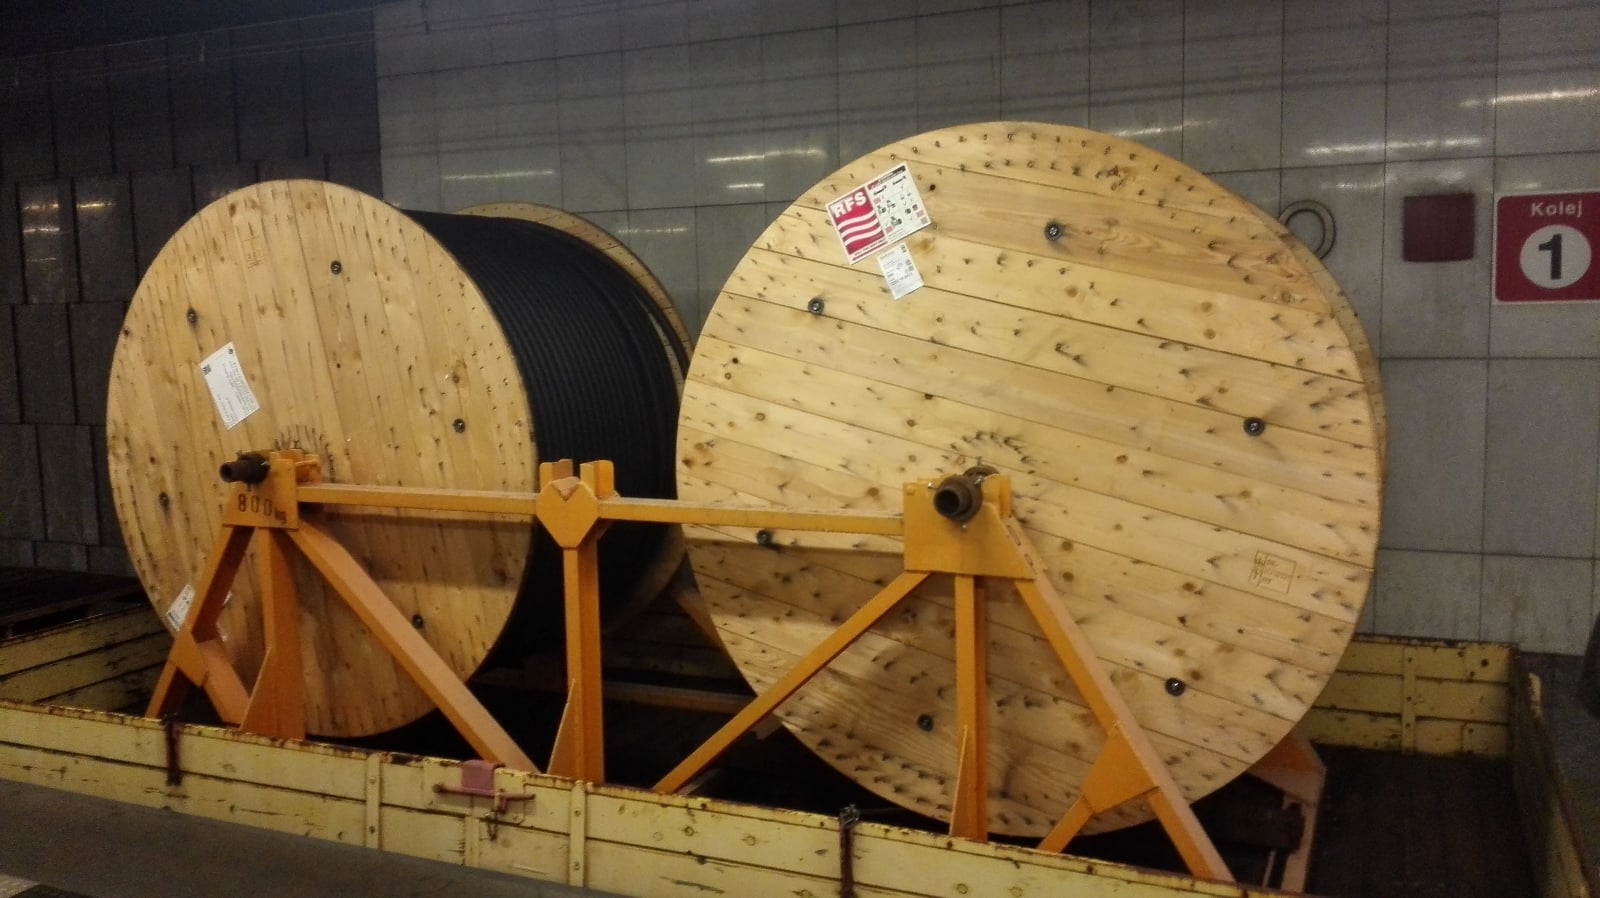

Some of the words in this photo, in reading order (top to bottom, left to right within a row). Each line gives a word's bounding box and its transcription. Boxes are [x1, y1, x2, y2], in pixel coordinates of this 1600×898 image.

[829, 191, 867, 218] RFS
[1531, 200, 1583, 218] Kolej
[1538, 233, 1563, 280] 1
[238, 493, 273, 517] 800
